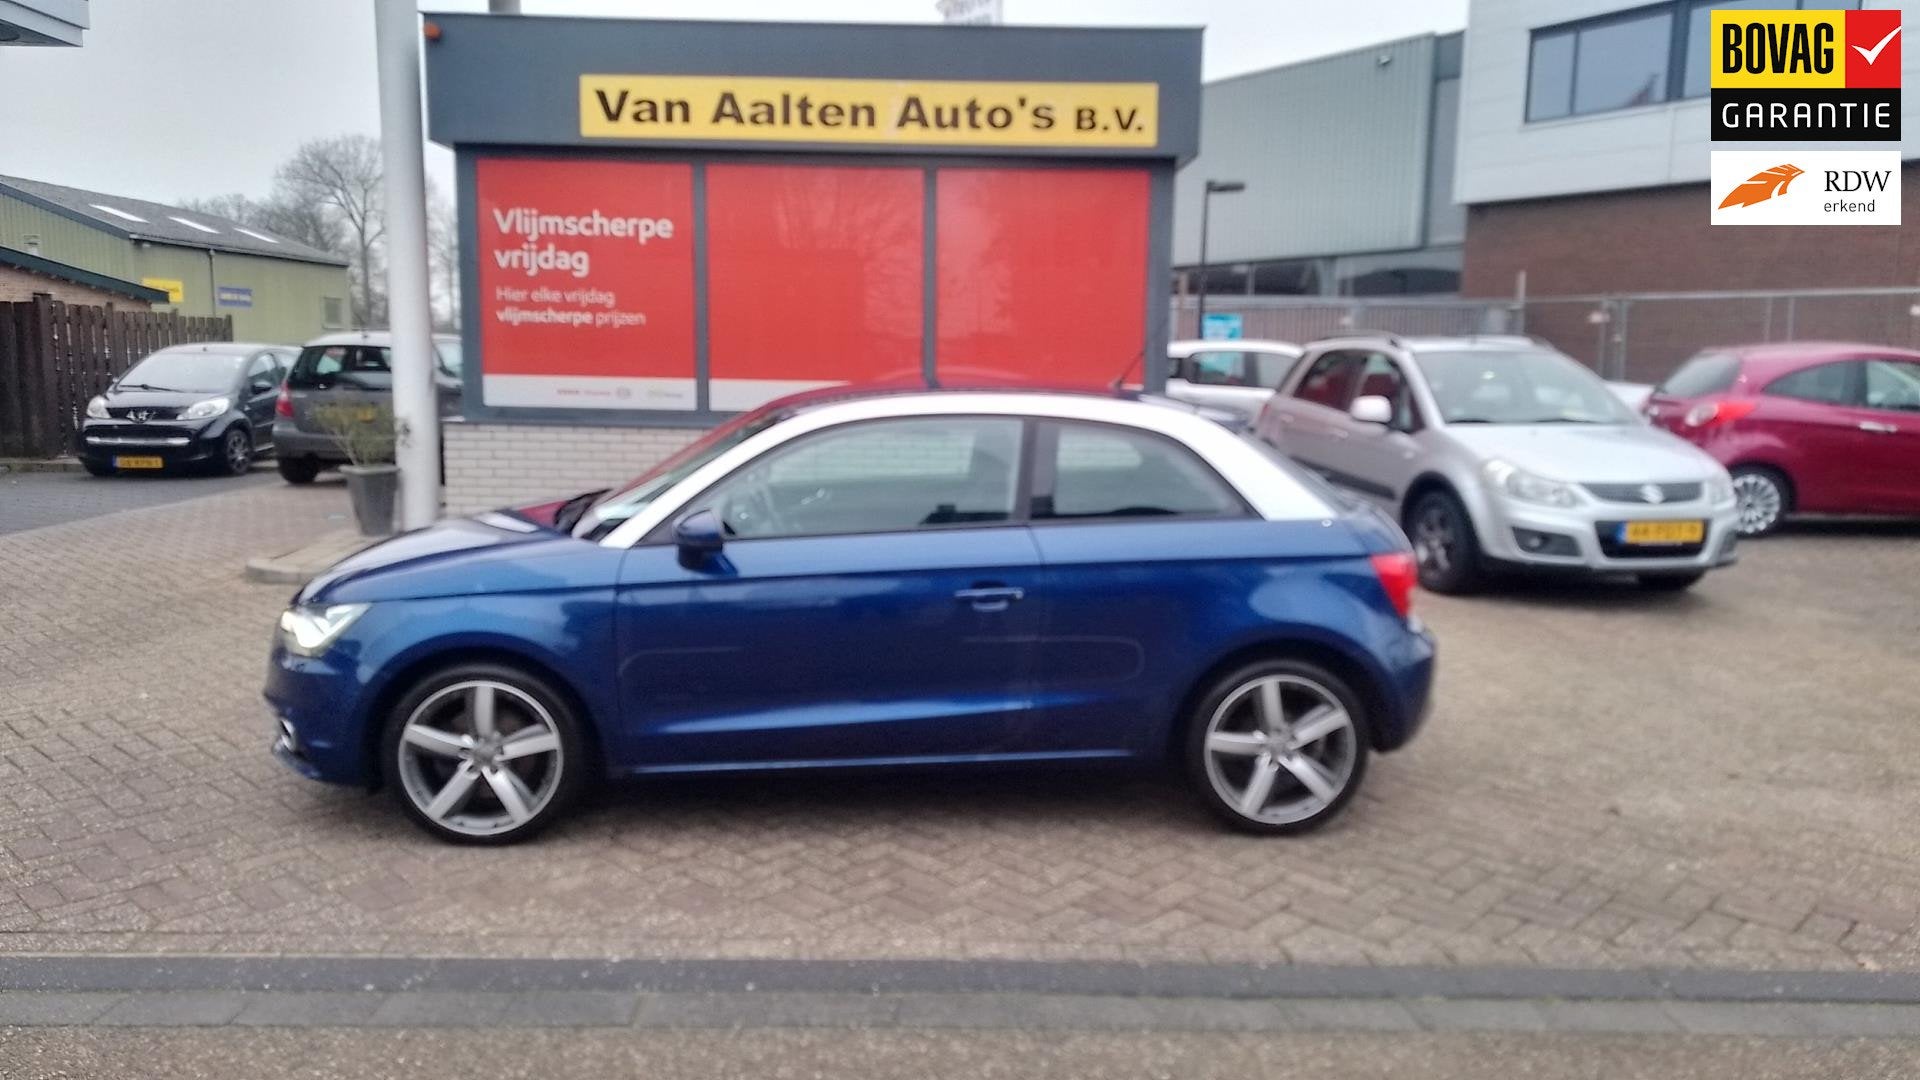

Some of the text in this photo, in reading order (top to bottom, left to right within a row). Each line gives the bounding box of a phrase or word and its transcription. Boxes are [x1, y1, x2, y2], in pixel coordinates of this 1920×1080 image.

[596, 90, 1143, 132] Van Aalten Auto's B.V.
[493, 207, 674, 245] Vlijmscherpe
[493, 243, 590, 278] vrijdag
[496, 286, 616, 308] Hier elke vrijdag
[496, 306, 646, 328] vlijmscherpe prijzen
